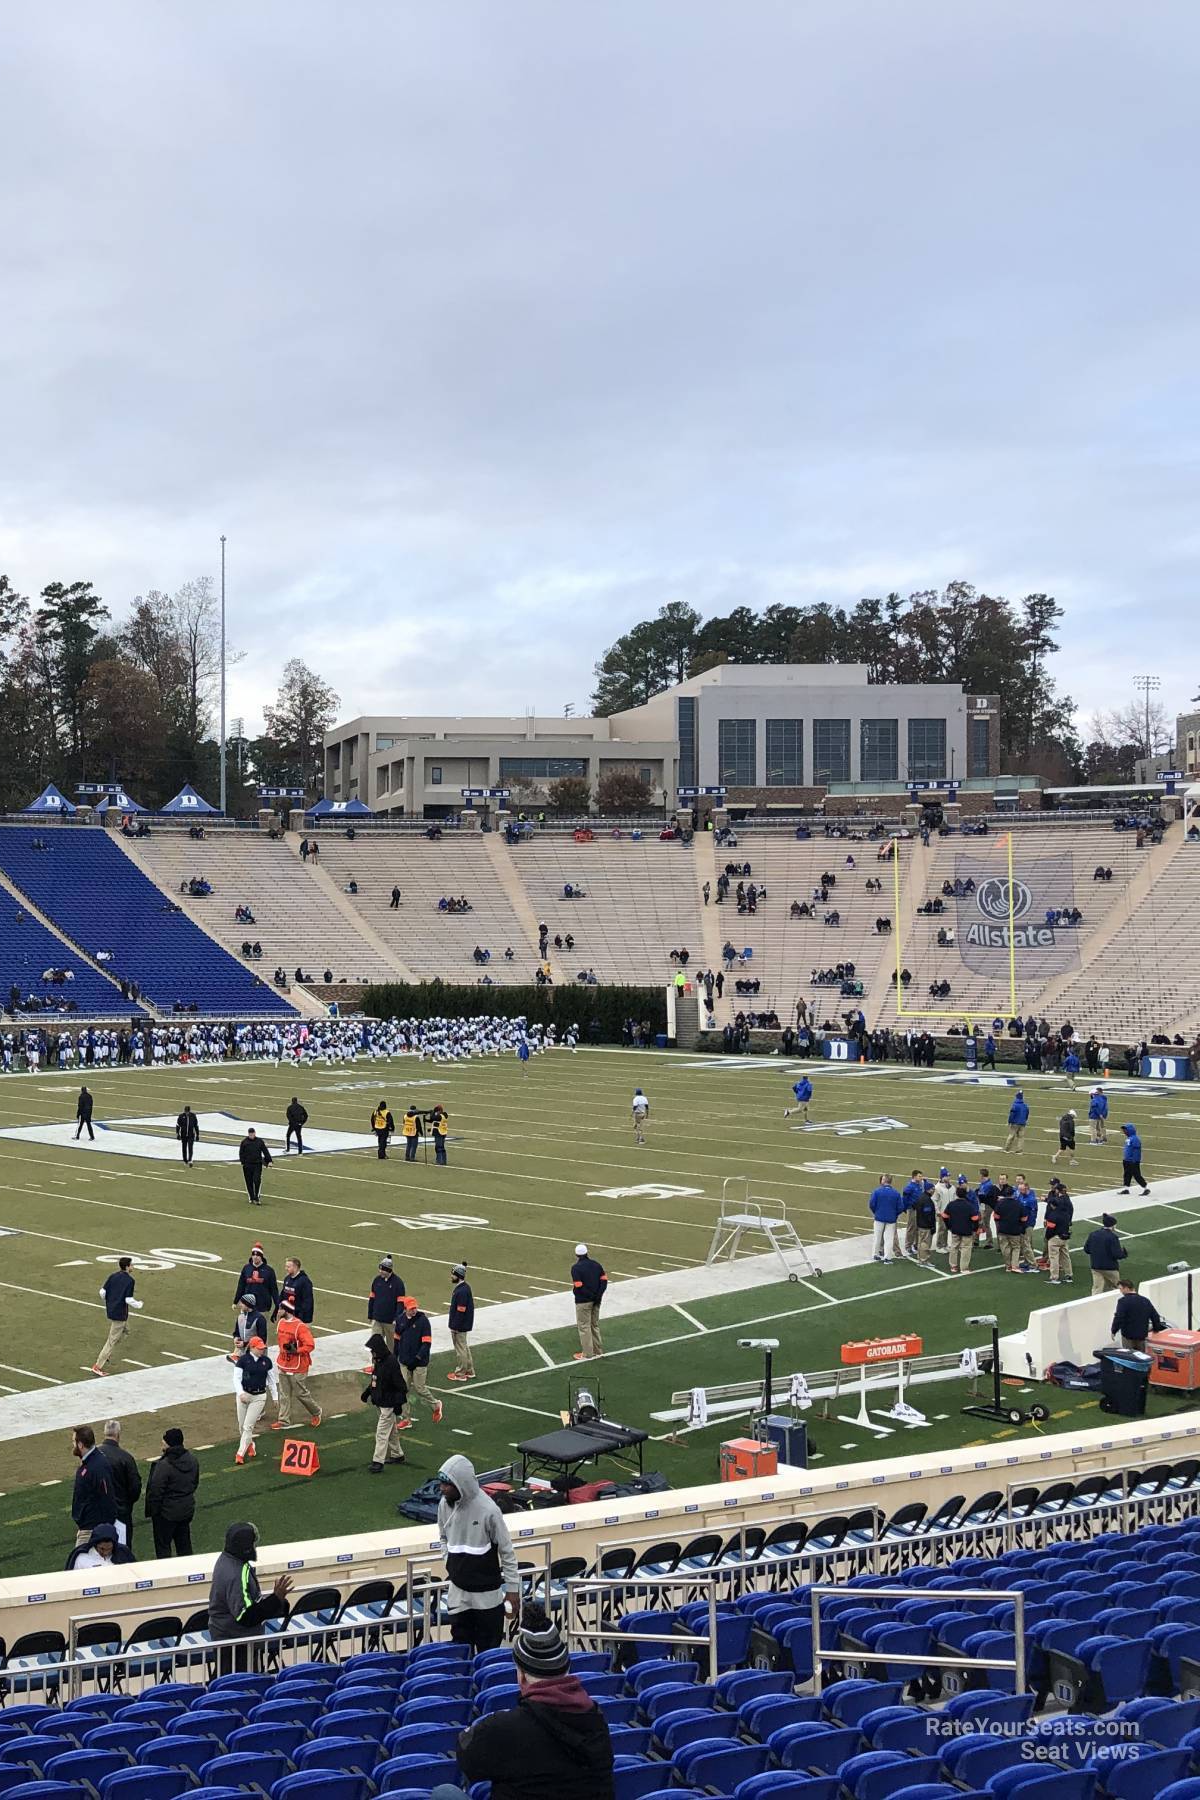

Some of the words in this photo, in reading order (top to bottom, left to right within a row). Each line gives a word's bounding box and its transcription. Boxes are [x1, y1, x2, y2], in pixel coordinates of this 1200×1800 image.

[181, 795, 198, 806] D
[966, 923, 1054, 947] Allstate
[829, 1041, 848, 1060] D
[1148, 1057, 1176, 1079] D
[390, 1213, 490, 1231] 40
[95, 1248, 223, 1270] 30
[866, 1344, 907, 1357] GATORADE
[285, 1443, 311, 1469] 20
